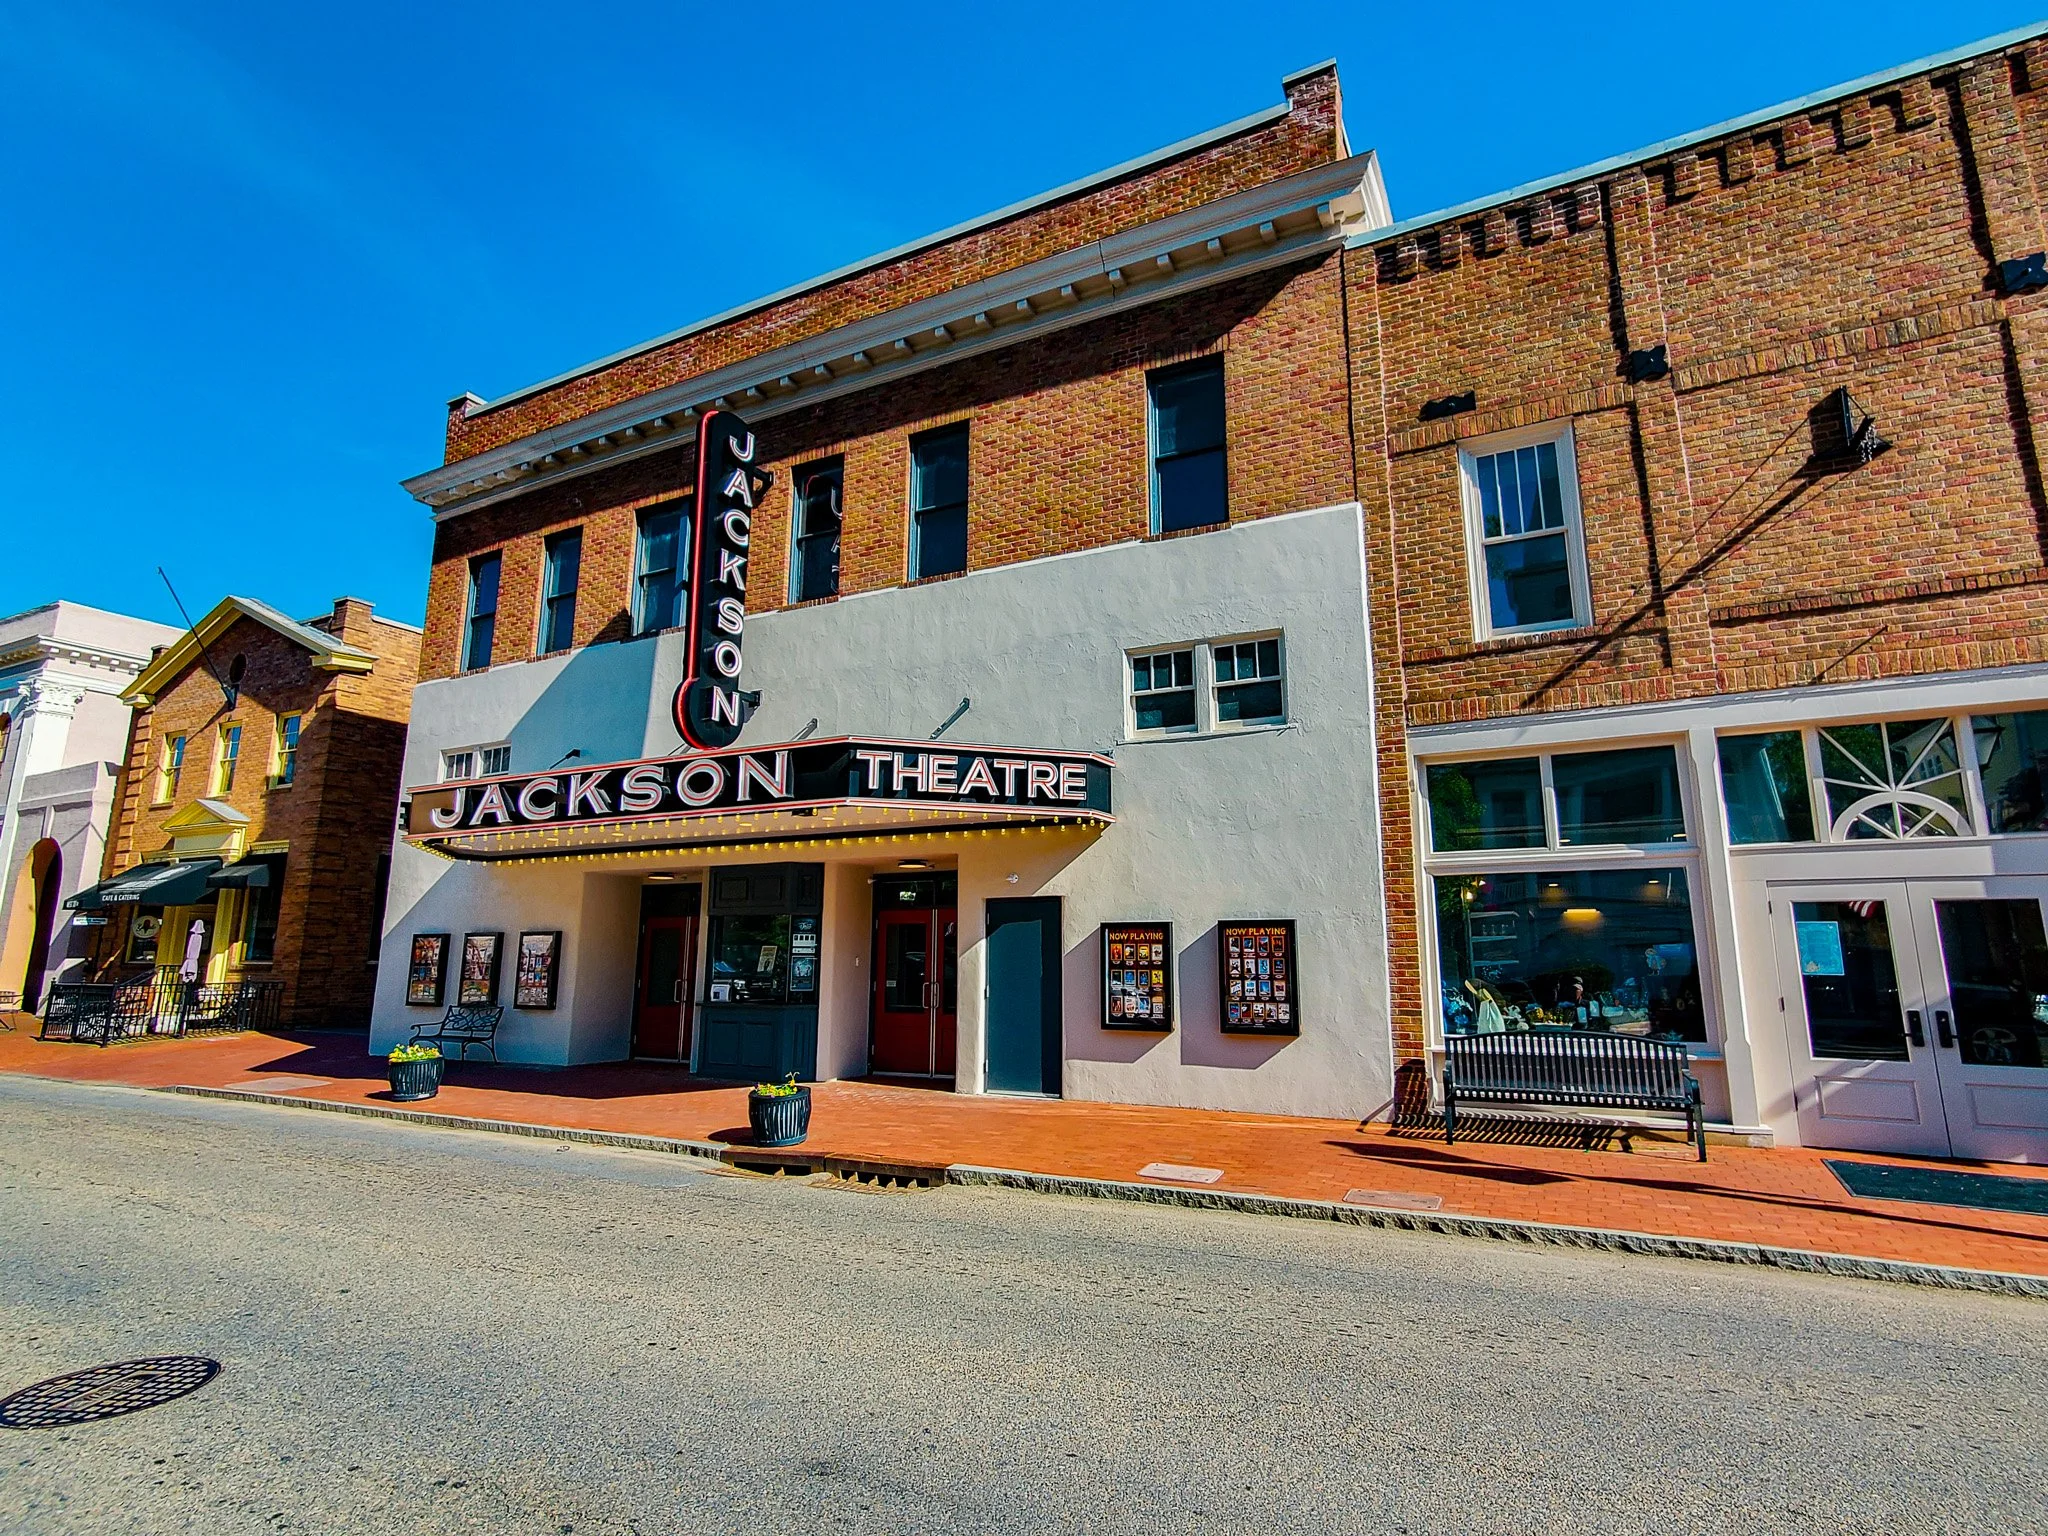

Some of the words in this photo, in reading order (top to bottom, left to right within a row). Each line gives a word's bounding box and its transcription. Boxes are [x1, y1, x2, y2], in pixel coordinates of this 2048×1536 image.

[710, 430, 756, 727] JACKSON
[430, 749, 793, 830] JACKSON
[856, 748, 1088, 803] THEATRE
[1109, 932, 1128, 940] NOW
[1130, 932, 1164, 940] PLAYING
[1226, 928, 1247, 936] NOW
[1249, 927, 1287, 936] PLAYING
